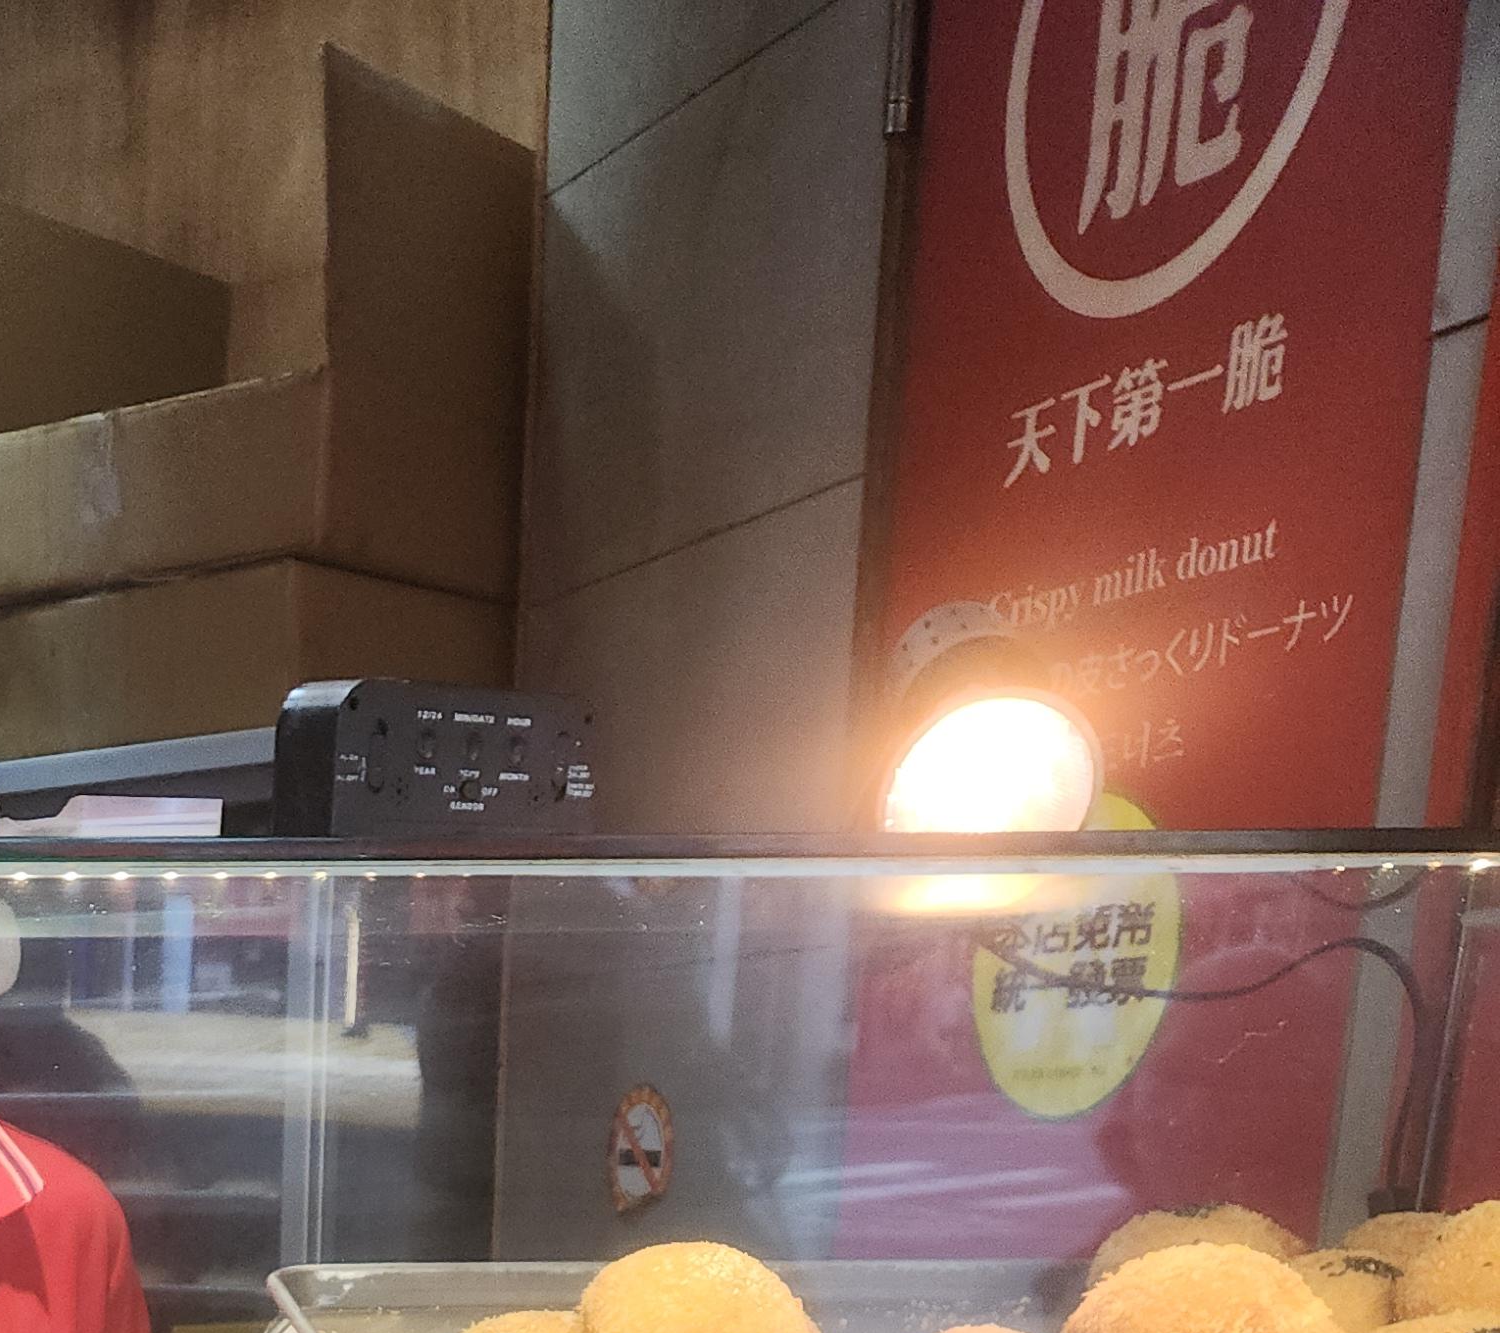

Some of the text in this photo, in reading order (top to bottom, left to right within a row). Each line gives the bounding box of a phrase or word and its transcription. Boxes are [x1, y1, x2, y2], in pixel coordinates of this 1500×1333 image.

[1003, 312, 1288, 488] 天下第一脆
[1092, 546, 1167, 606] milk
[1175, 518, 1279, 582] donut
[1050, 593, 1354, 692] の皮さっくりドーナツ
